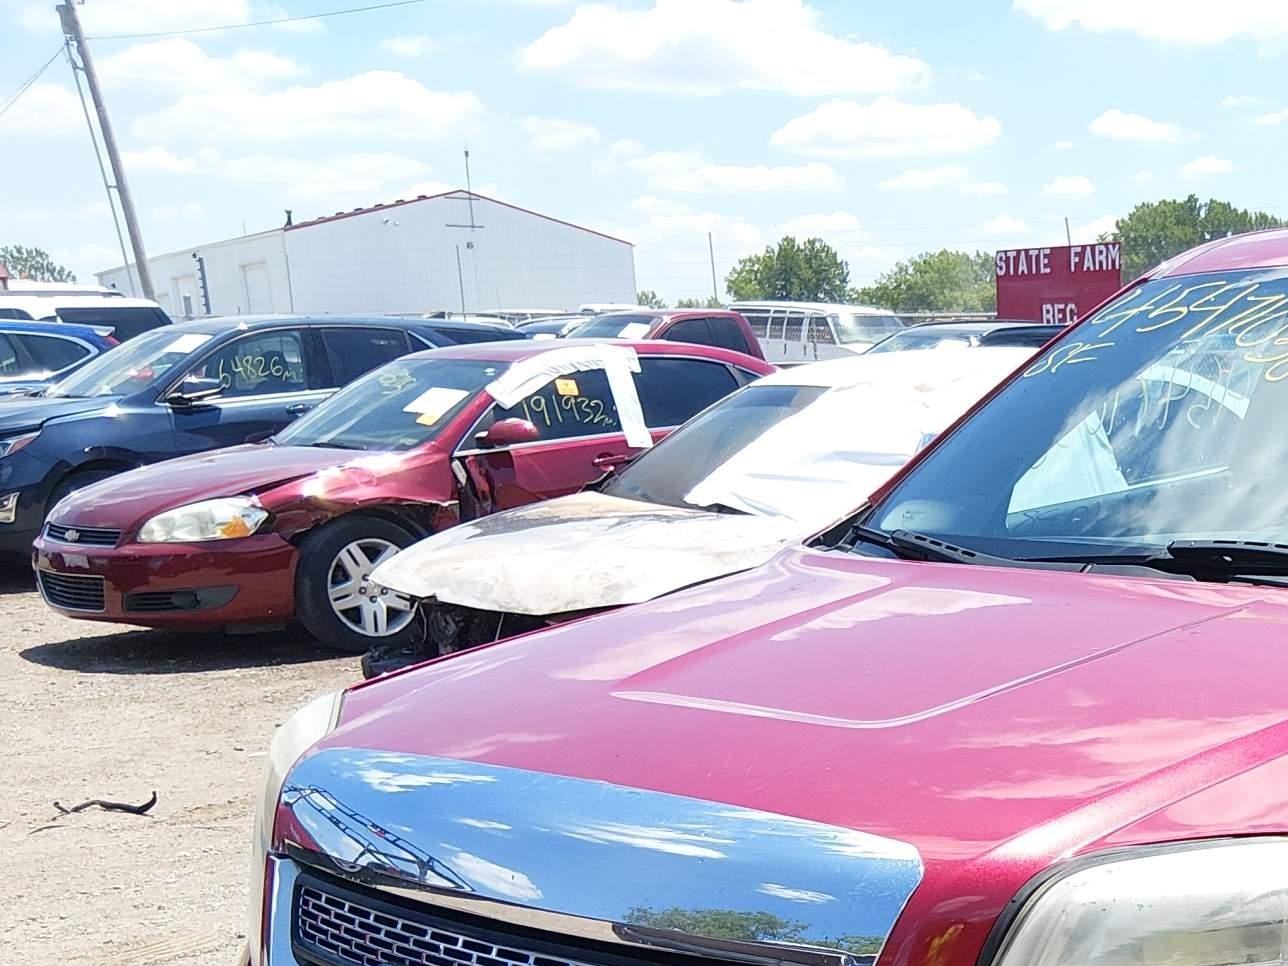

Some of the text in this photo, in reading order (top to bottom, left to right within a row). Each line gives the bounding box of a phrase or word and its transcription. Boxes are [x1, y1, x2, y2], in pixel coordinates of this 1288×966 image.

[996, 243, 1121, 277] STATE FARM
[219, 355, 283, 388] 64826
